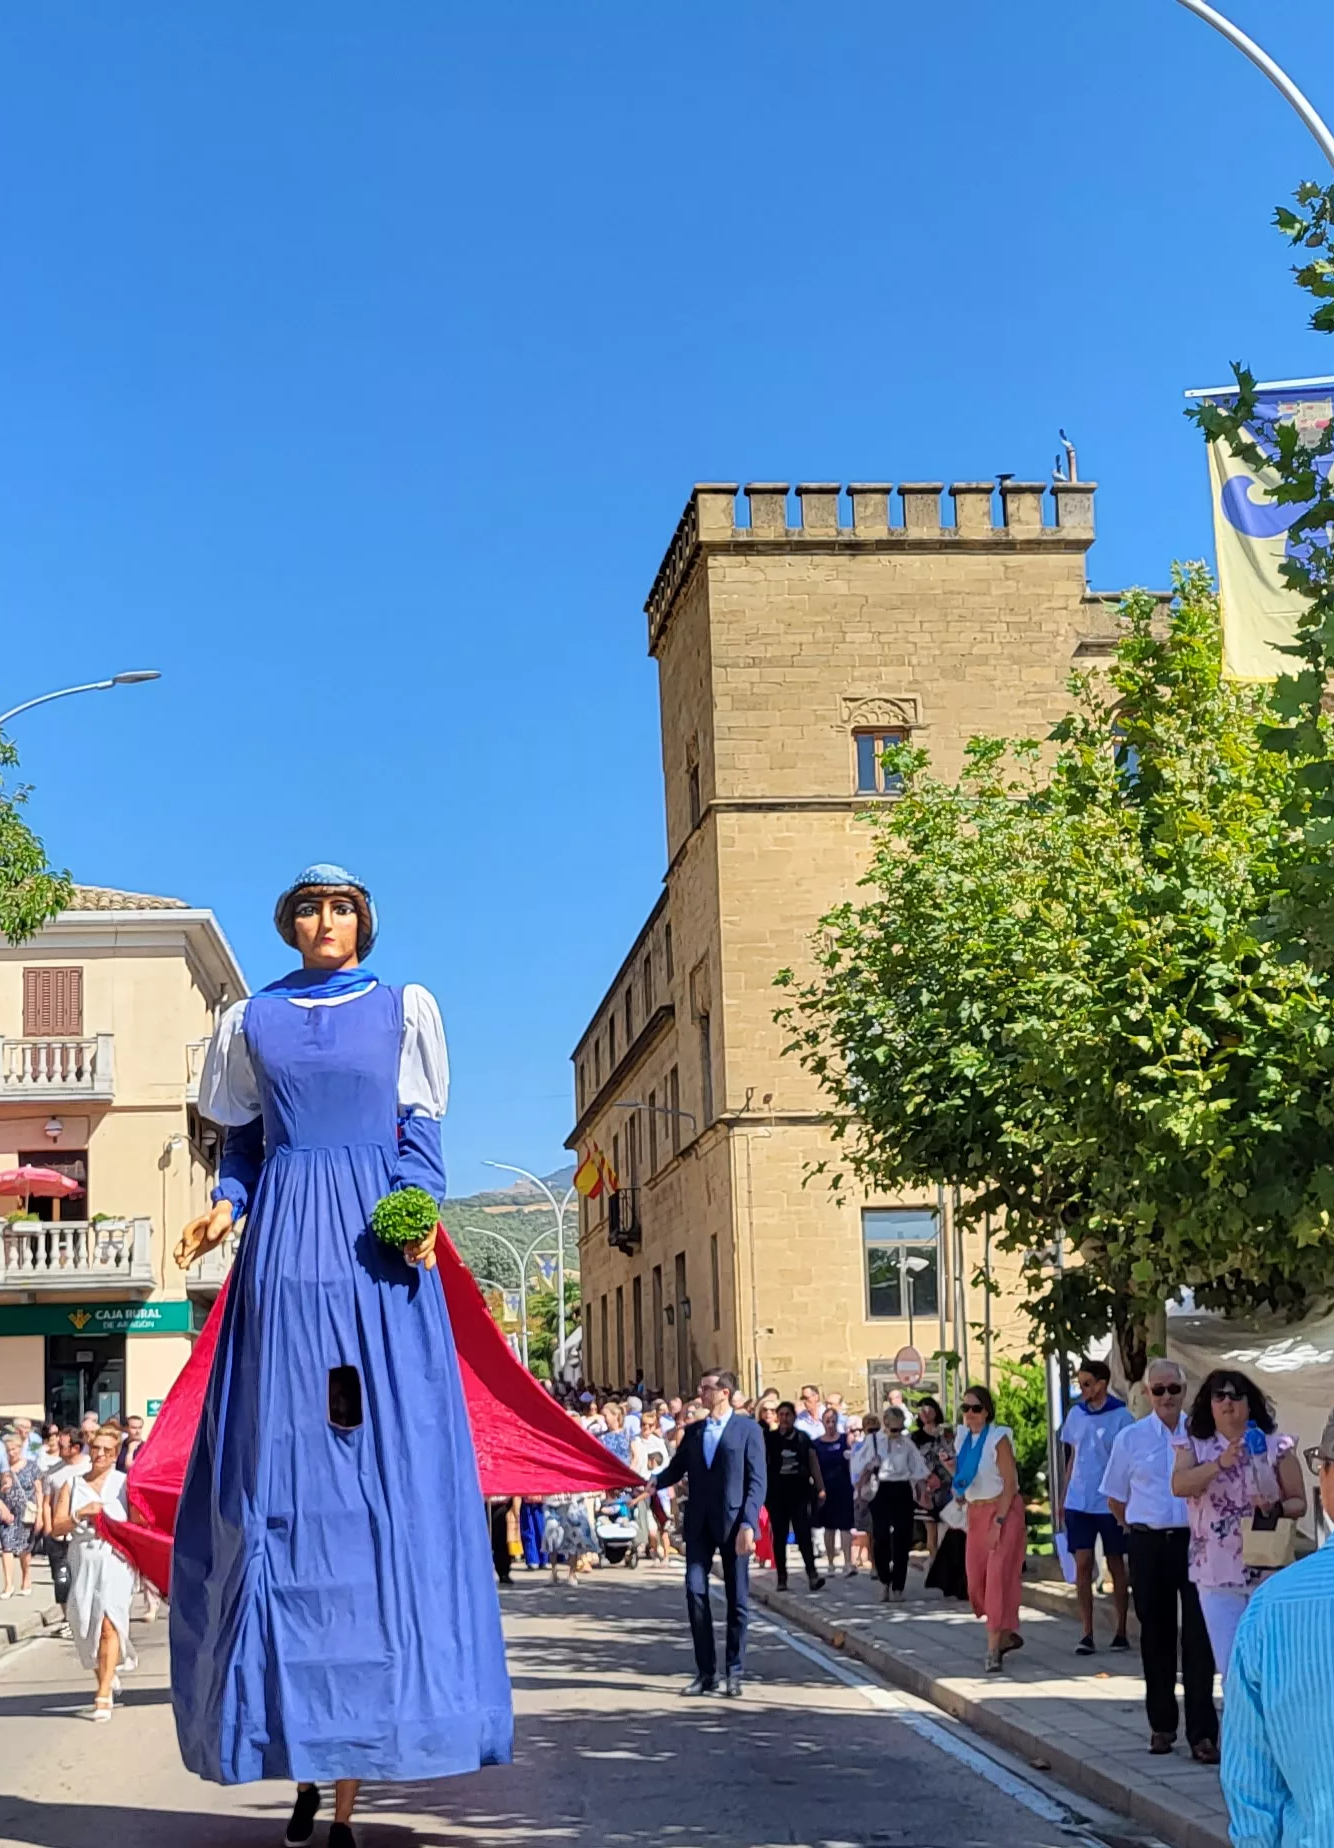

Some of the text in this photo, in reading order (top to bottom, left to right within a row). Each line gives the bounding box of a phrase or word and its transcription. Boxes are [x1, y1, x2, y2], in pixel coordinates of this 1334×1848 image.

[95, 1309, 161, 1320] CAJA RURAL
[103, 1321, 114, 1329] DE
